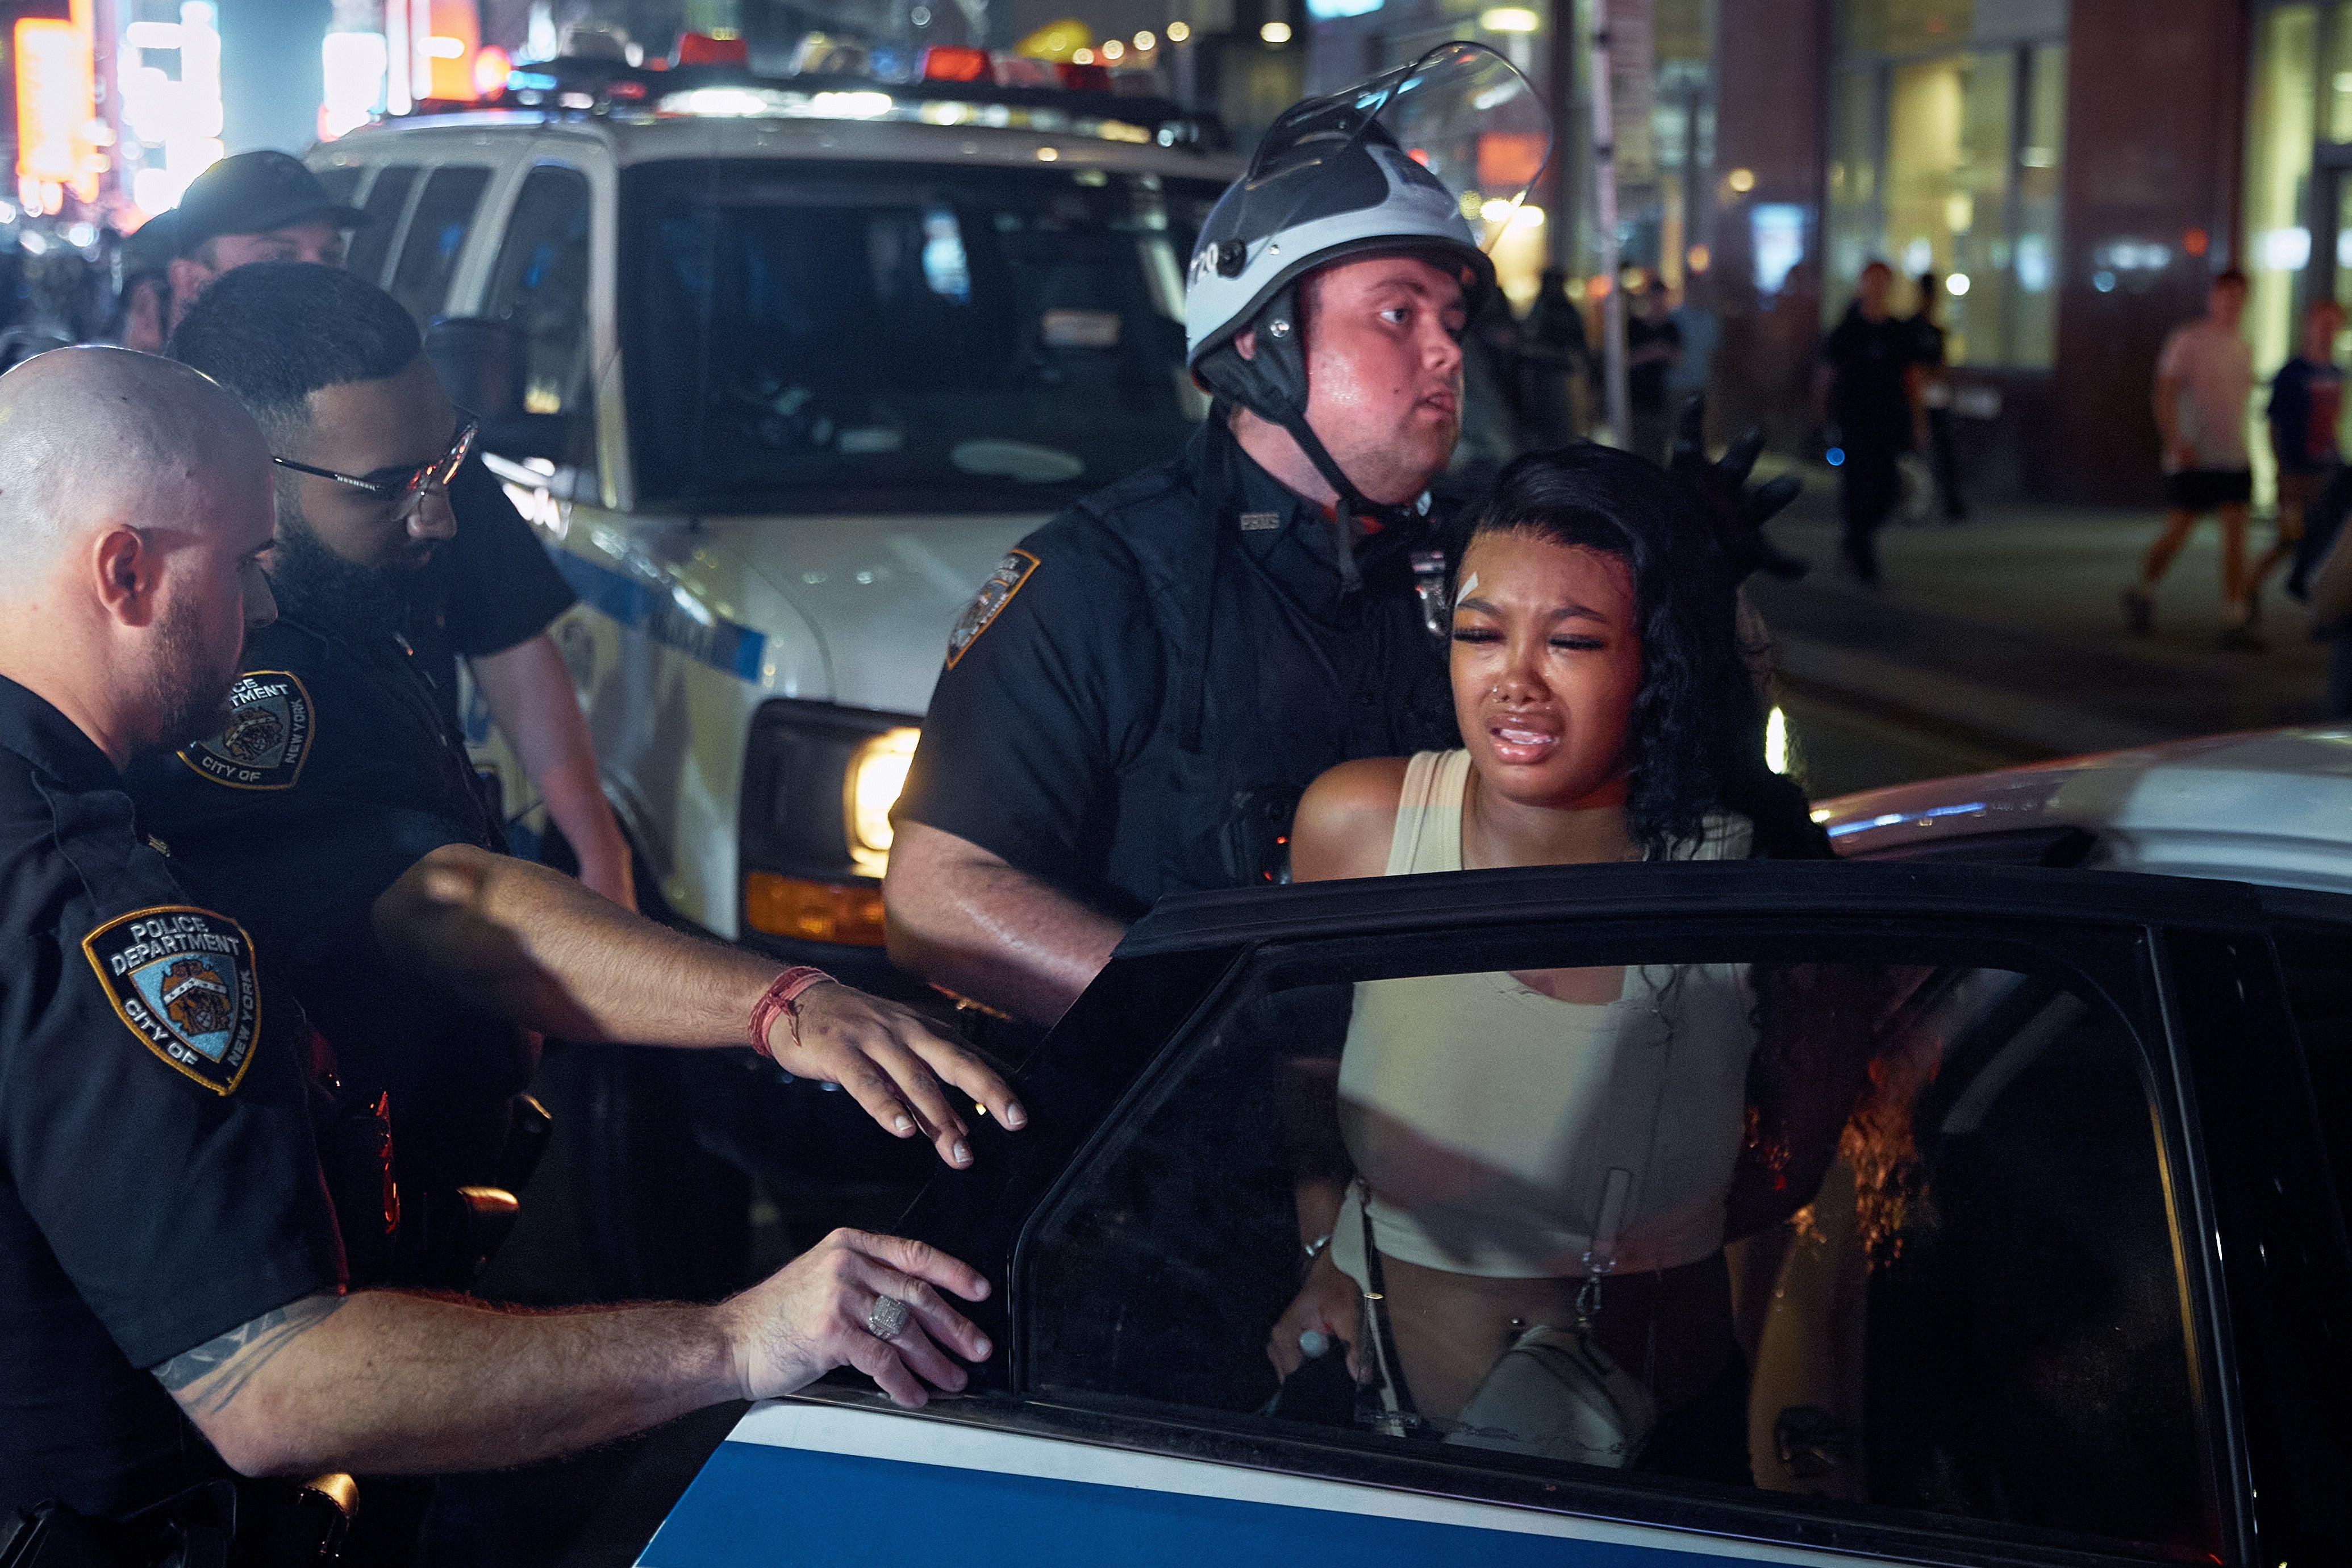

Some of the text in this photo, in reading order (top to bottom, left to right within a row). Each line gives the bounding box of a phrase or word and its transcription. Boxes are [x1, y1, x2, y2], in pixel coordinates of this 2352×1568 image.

[230, 684, 288, 707] TMENT
[202, 698, 306, 782] CITY OF NEW YORK
[130, 915, 209, 943] POLICE
[111, 933, 239, 976] DEPARTMENT
[124, 969, 253, 1066] CITY OF NEW YORK
